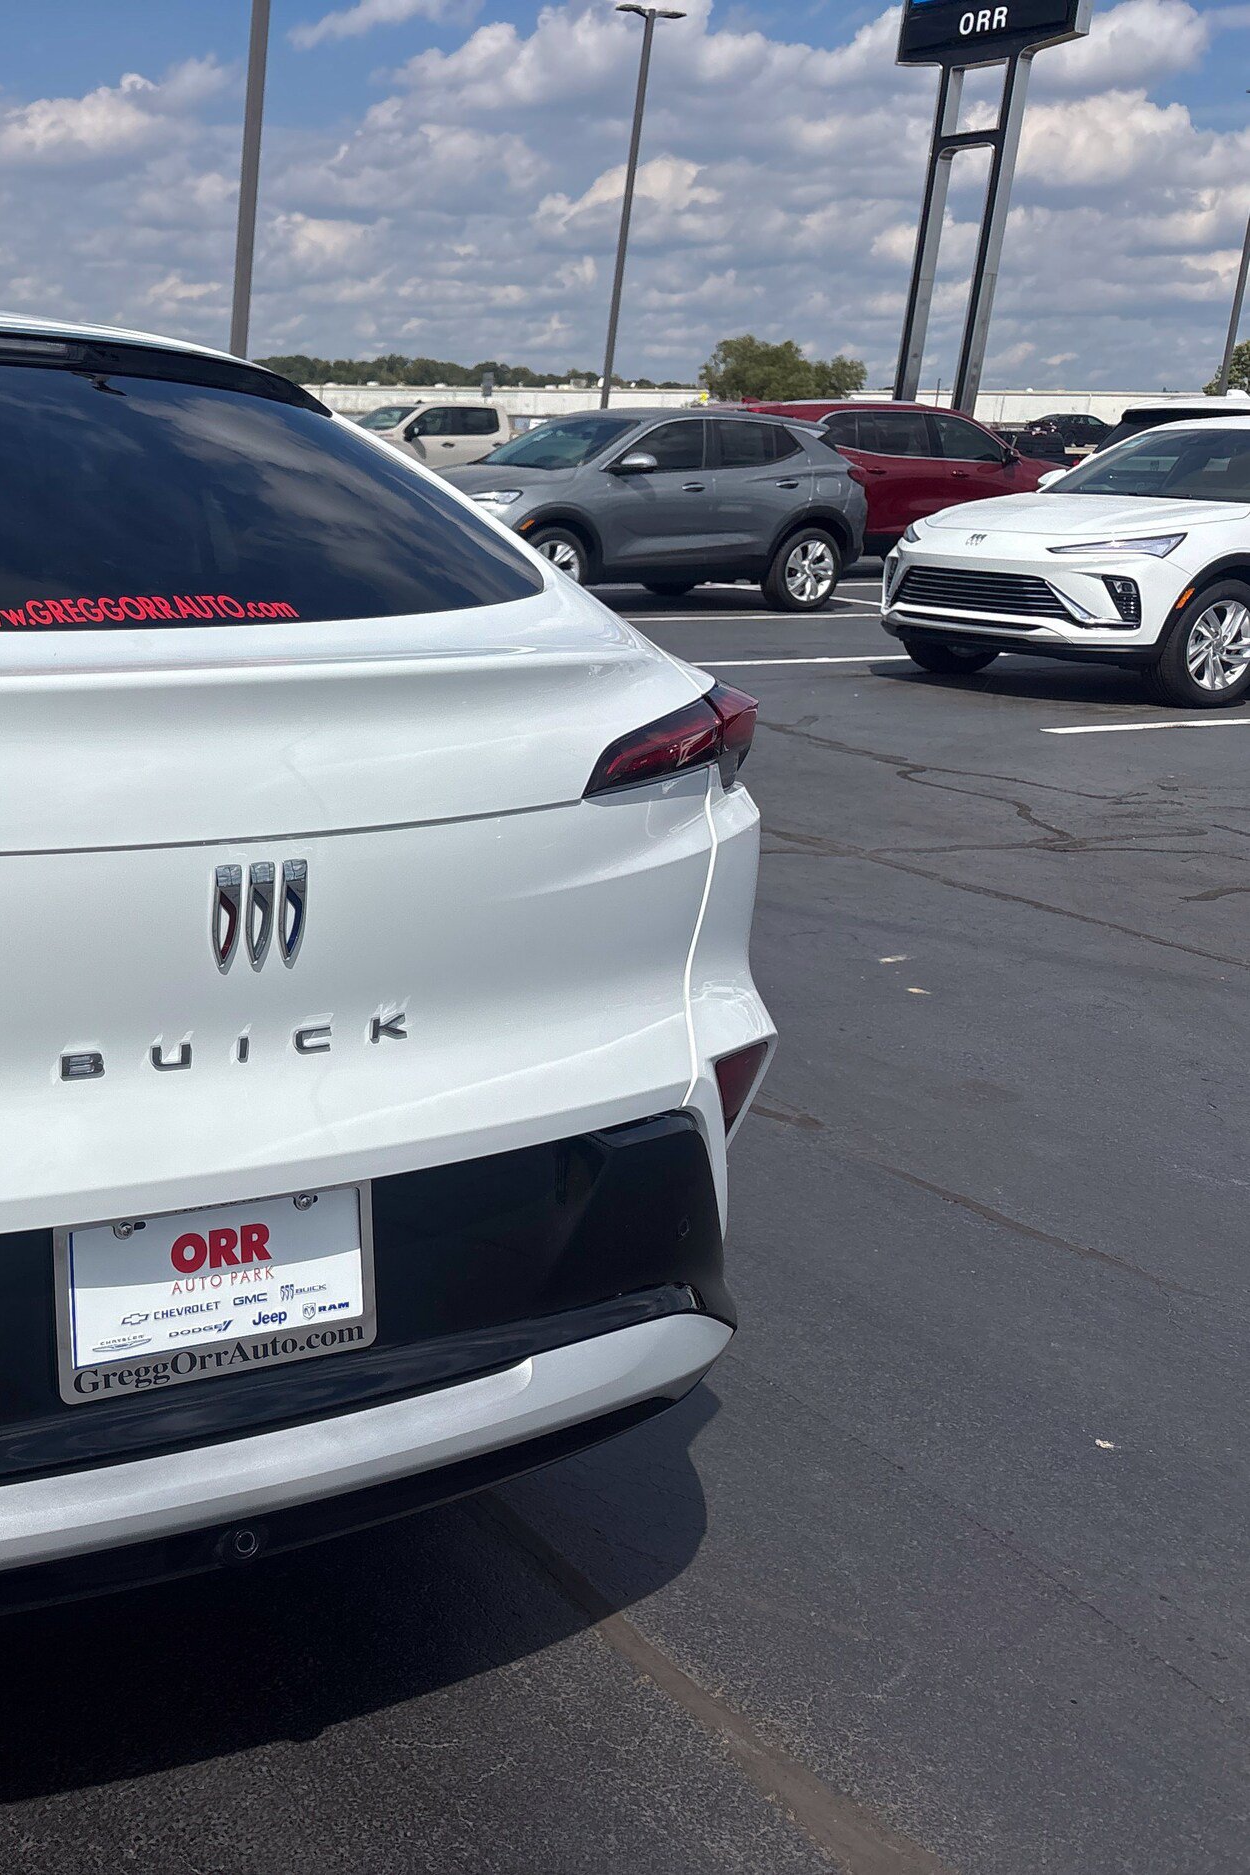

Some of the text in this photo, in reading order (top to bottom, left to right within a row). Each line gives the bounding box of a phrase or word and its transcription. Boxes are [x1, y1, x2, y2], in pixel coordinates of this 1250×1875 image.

[959, 6, 1008, 35] ORR
[59, 1012, 408, 1082] BUICK
[170, 1222, 273, 1274] ORR
[171, 1265, 275, 1295] AUTO PARK
[295, 1284, 327, 1294] BUICK
[233, 1292, 268, 1306] GMC
[318, 1301, 350, 1313] RAM
[153, 1300, 221, 1320] CHEVROLET
[252, 1310, 288, 1326] Jeep
[168, 1323, 223, 1338] DODGE
[72, 1324, 365, 1395] GreggOrrAuto.com
